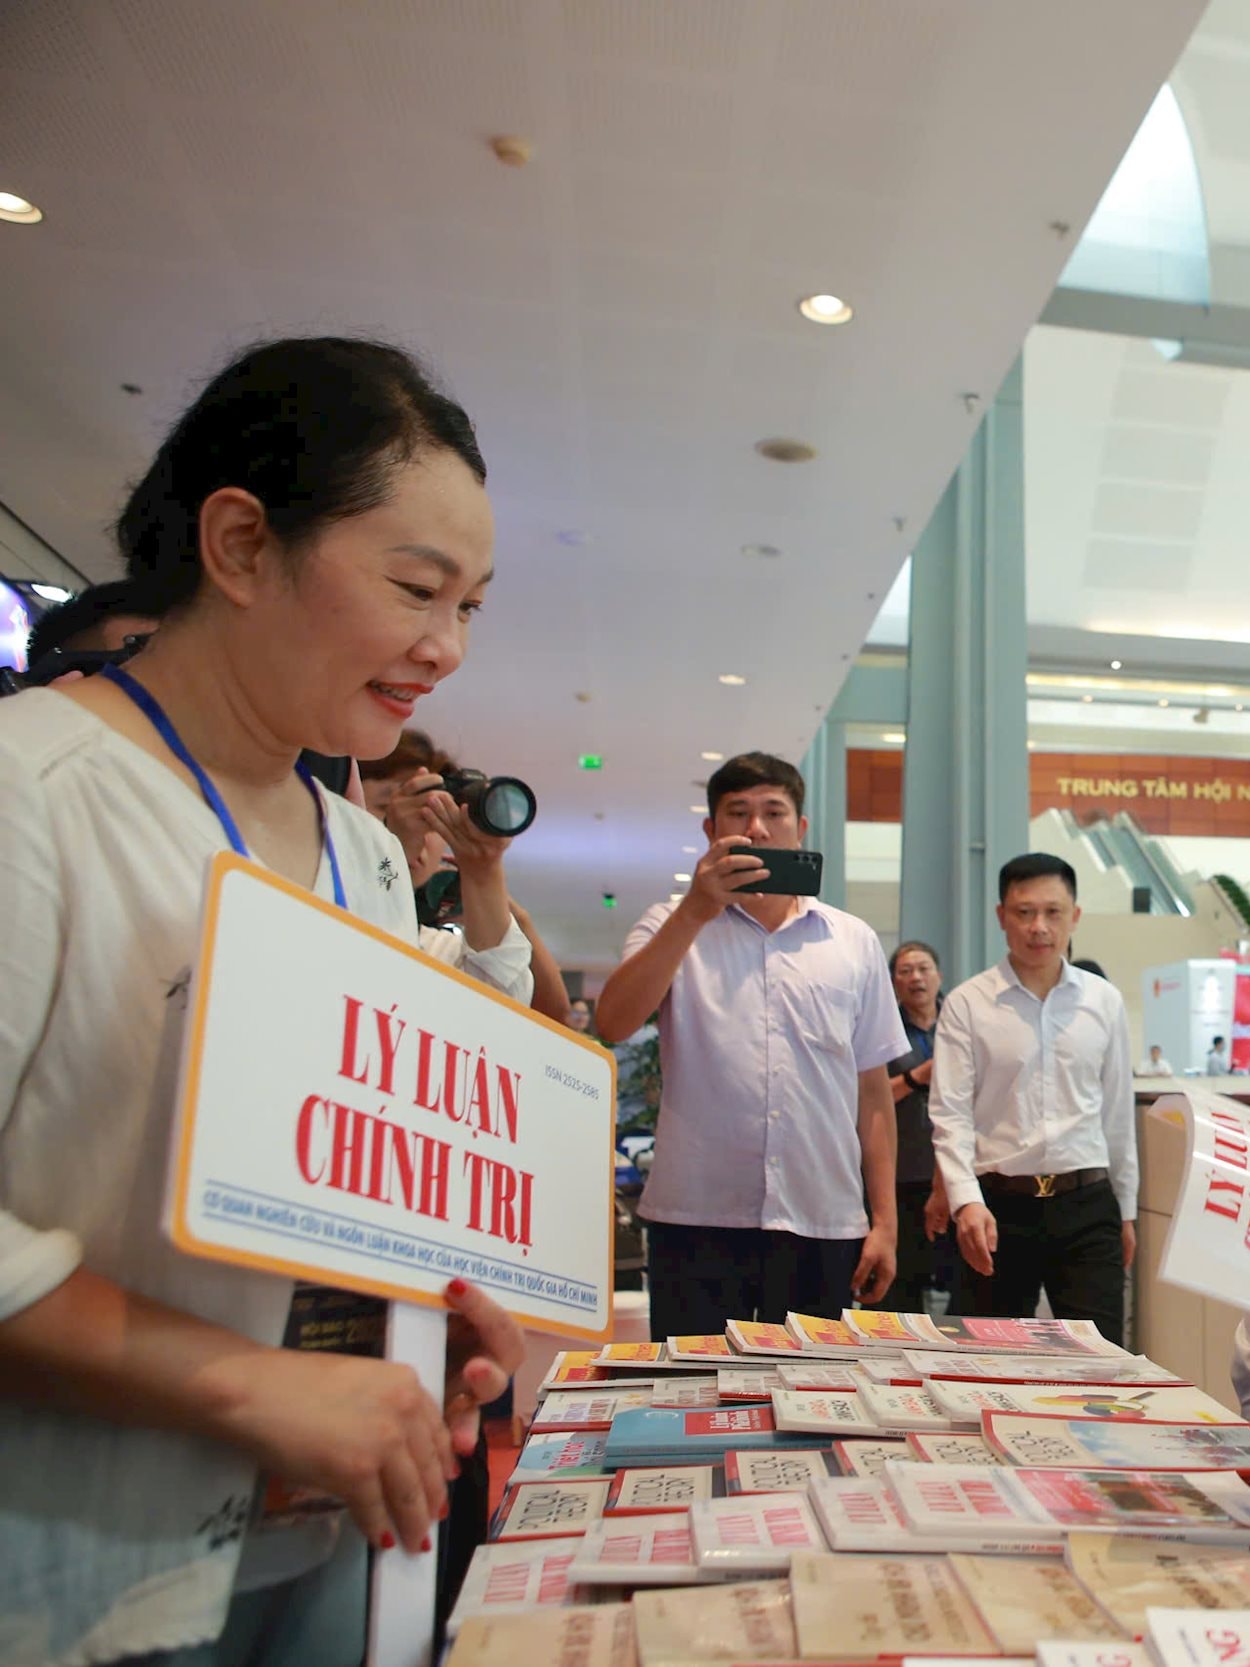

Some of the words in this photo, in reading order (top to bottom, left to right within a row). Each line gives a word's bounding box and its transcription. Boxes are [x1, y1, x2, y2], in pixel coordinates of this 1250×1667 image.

[1057, 778, 1138, 798] TRUNG
[1142, 776, 1187, 799] TÂM
[1193, 778, 1232, 804] HỘI
[338, 995, 407, 1097] LÝ
[414, 1029, 522, 1144] LUẬN
[545, 1064, 562, 1082] ISSN
[296, 1093, 452, 1222] CHÍNH
[463, 1151, 535, 1257] TRỊ
[1204, 1169, 1245, 1223] LÝ
[392, 1241, 416, 1259] KHOA
[417, 1247, 435, 1264] HỌC
[453, 1257, 469, 1274] HỌC
[471, 1260, 489, 1279] VIỆN
[490, 1265, 513, 1284] CHÍNH
[526, 1275, 545, 1292] QUỐC
[546, 1282, 557, 1296] GIA
[558, 1282, 568, 1298] HỒ
[569, 1285, 580, 1301] CHÍ
[580, 1289, 598, 1306] MINH
